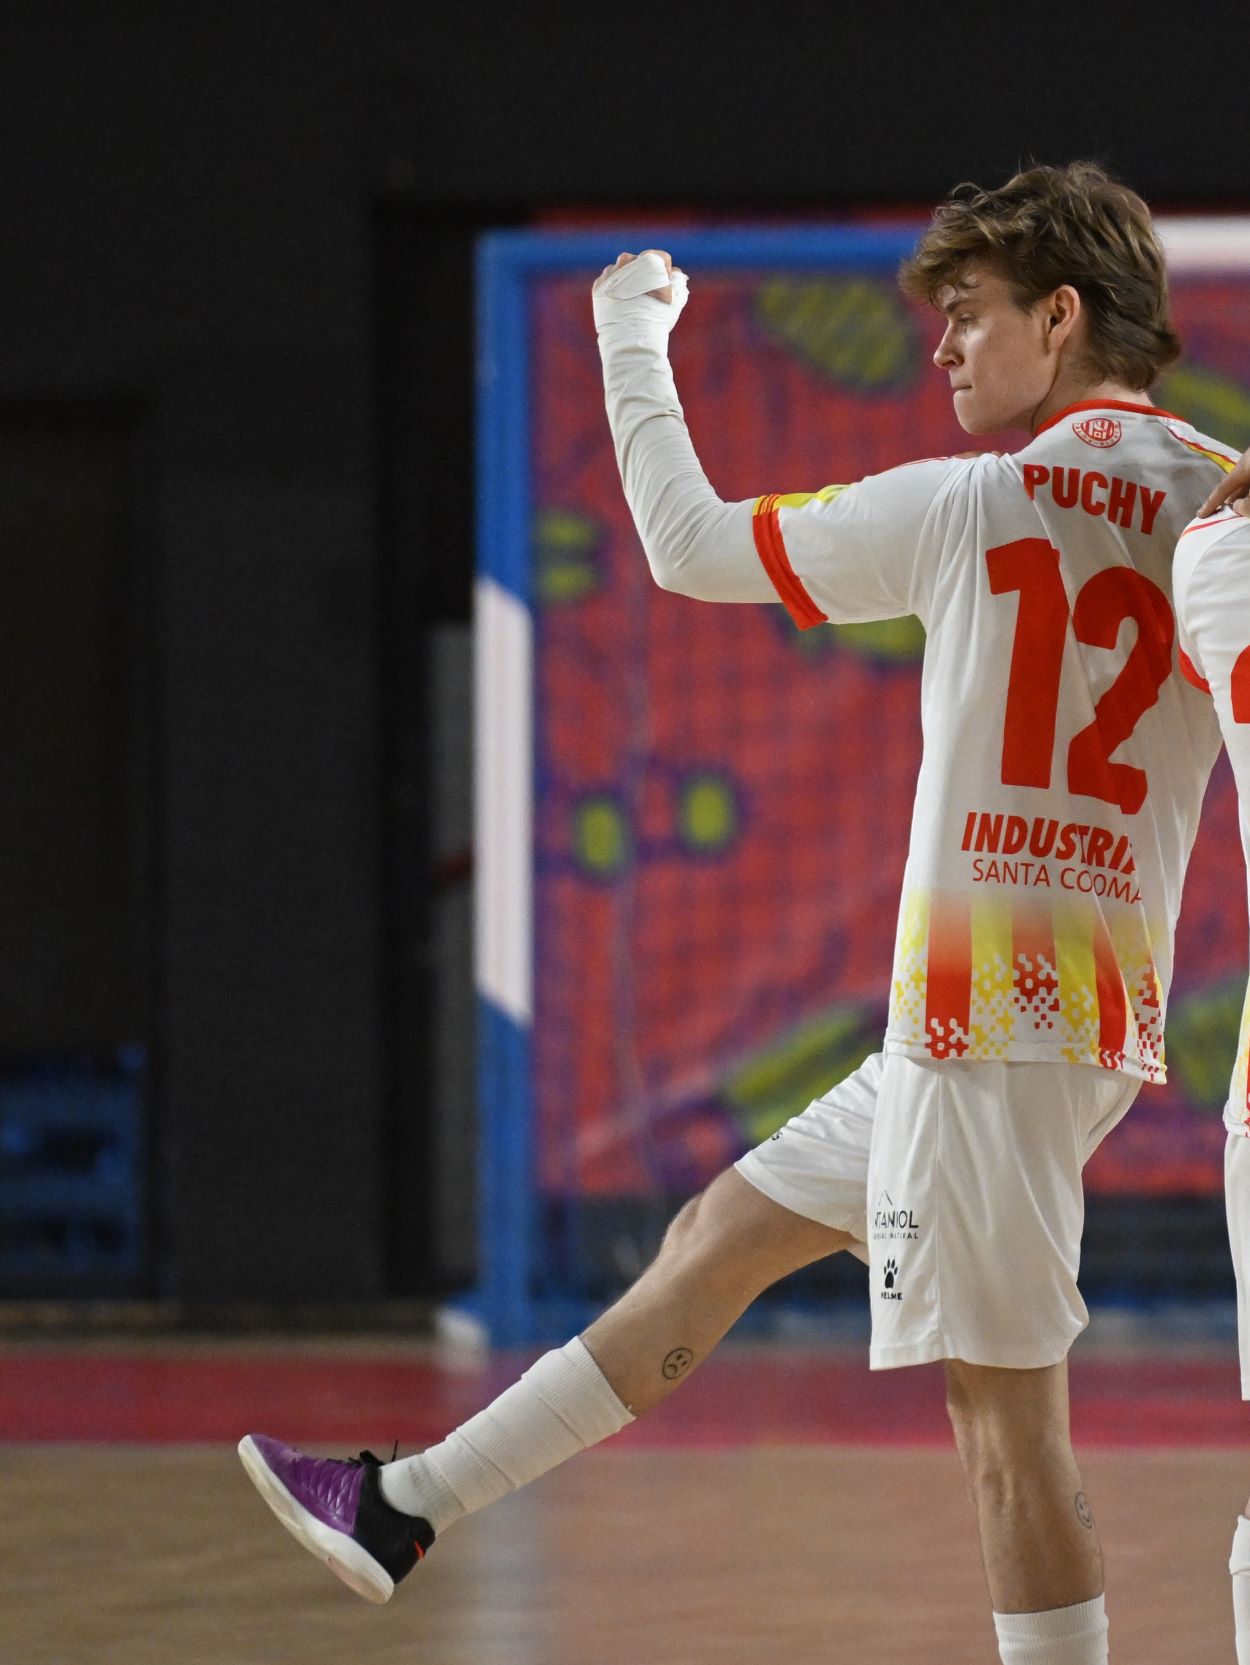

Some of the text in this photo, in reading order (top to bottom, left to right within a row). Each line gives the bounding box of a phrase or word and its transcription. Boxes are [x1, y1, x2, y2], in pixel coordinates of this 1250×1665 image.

[1023, 464, 1166, 535] PUCHY
[985, 538, 1175, 815] 12
[972, 859, 1050, 887] SANTA
